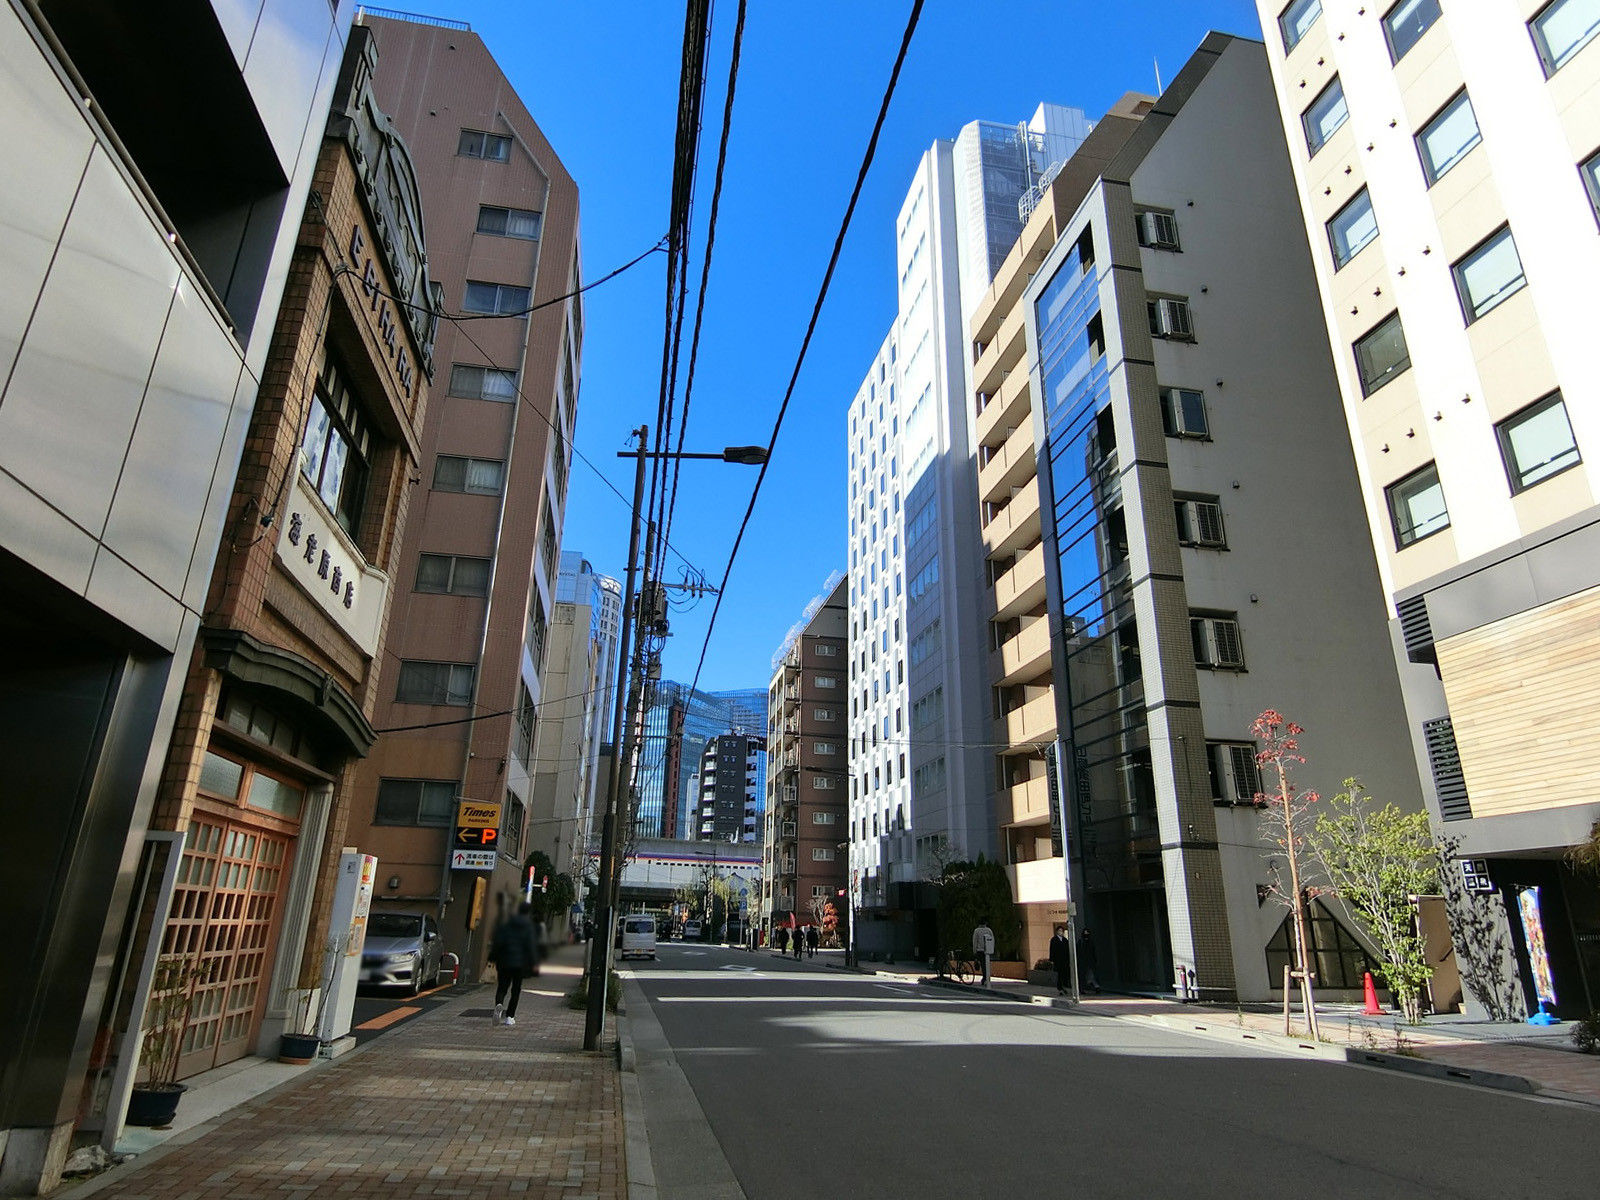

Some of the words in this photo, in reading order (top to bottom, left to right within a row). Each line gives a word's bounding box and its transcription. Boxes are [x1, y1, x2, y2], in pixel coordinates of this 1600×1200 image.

[350, 224, 413, 398] EBIHARA
[288, 512, 354, 609] 海老原商店
[463, 807, 496, 817] Times
[481, 828, 496, 844] P
